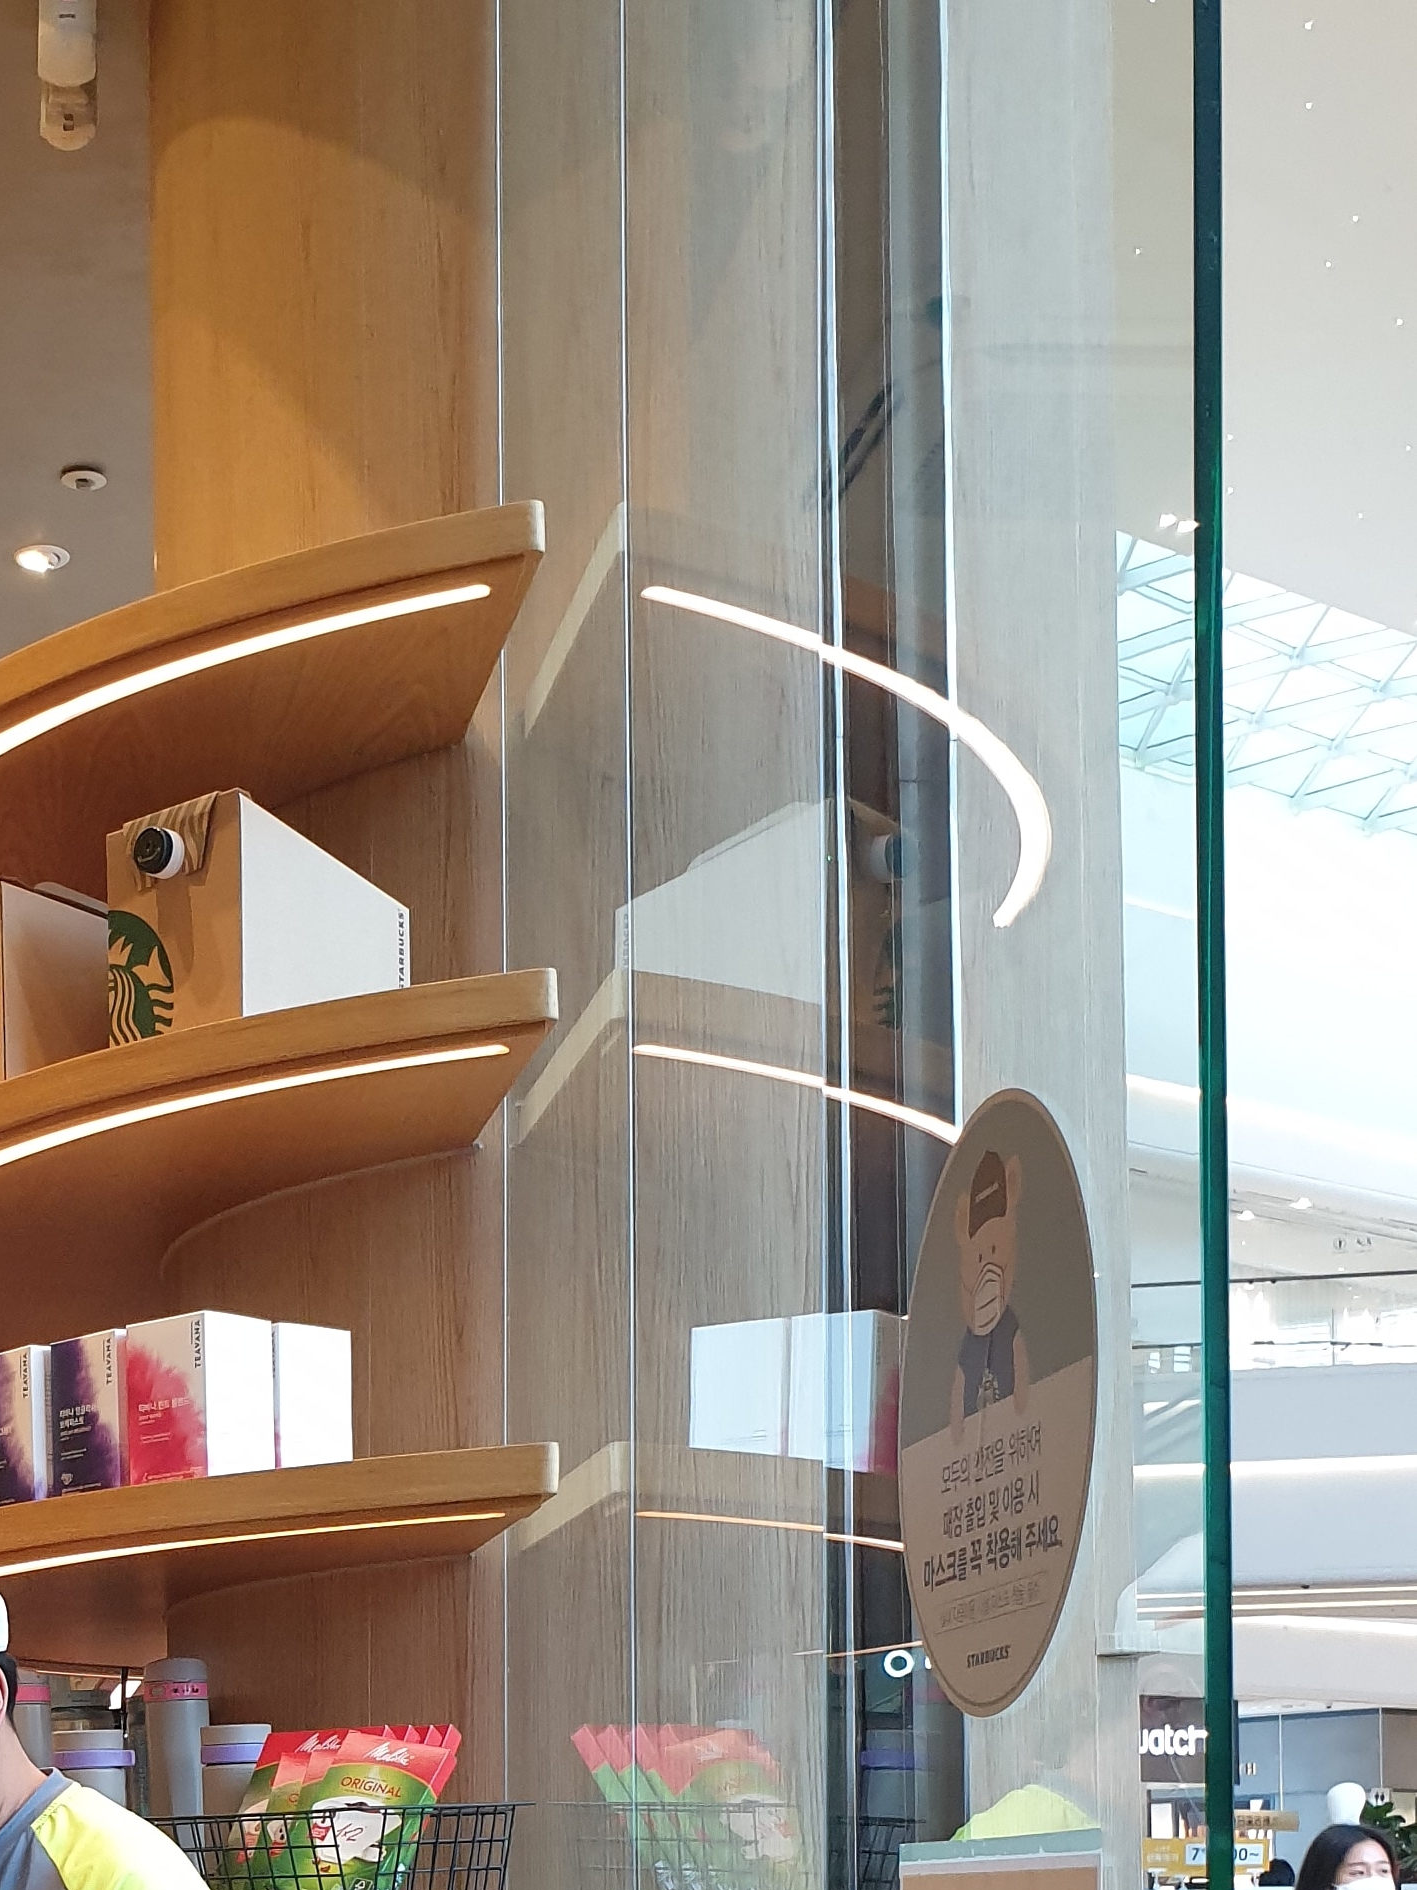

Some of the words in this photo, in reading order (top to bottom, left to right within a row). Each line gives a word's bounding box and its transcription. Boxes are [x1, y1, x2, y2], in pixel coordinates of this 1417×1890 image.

[941, 1454, 971, 1494] 모두의
[974, 1438, 1005, 1483] 안전을
[1008, 1419, 1042, 1466] 위하여
[943, 1503, 963, 1539] 매장
[965, 1494, 986, 1533] 출입
[989, 1487, 1001, 1525] 및
[1002, 1476, 1025, 1516] 이용
[1028, 1469, 1040, 1506] 시
[923, 1546, 968, 1591] 마스크를
[970, 1538, 983, 1576] 꼭
[985, 1526, 1023, 1570] 착용해
[1025, 1514, 1063, 1557] 주세요.
[967, 1646, 1009, 1668] STARBUCKS
[341, 1777, 401, 1797] ORIGINAL
